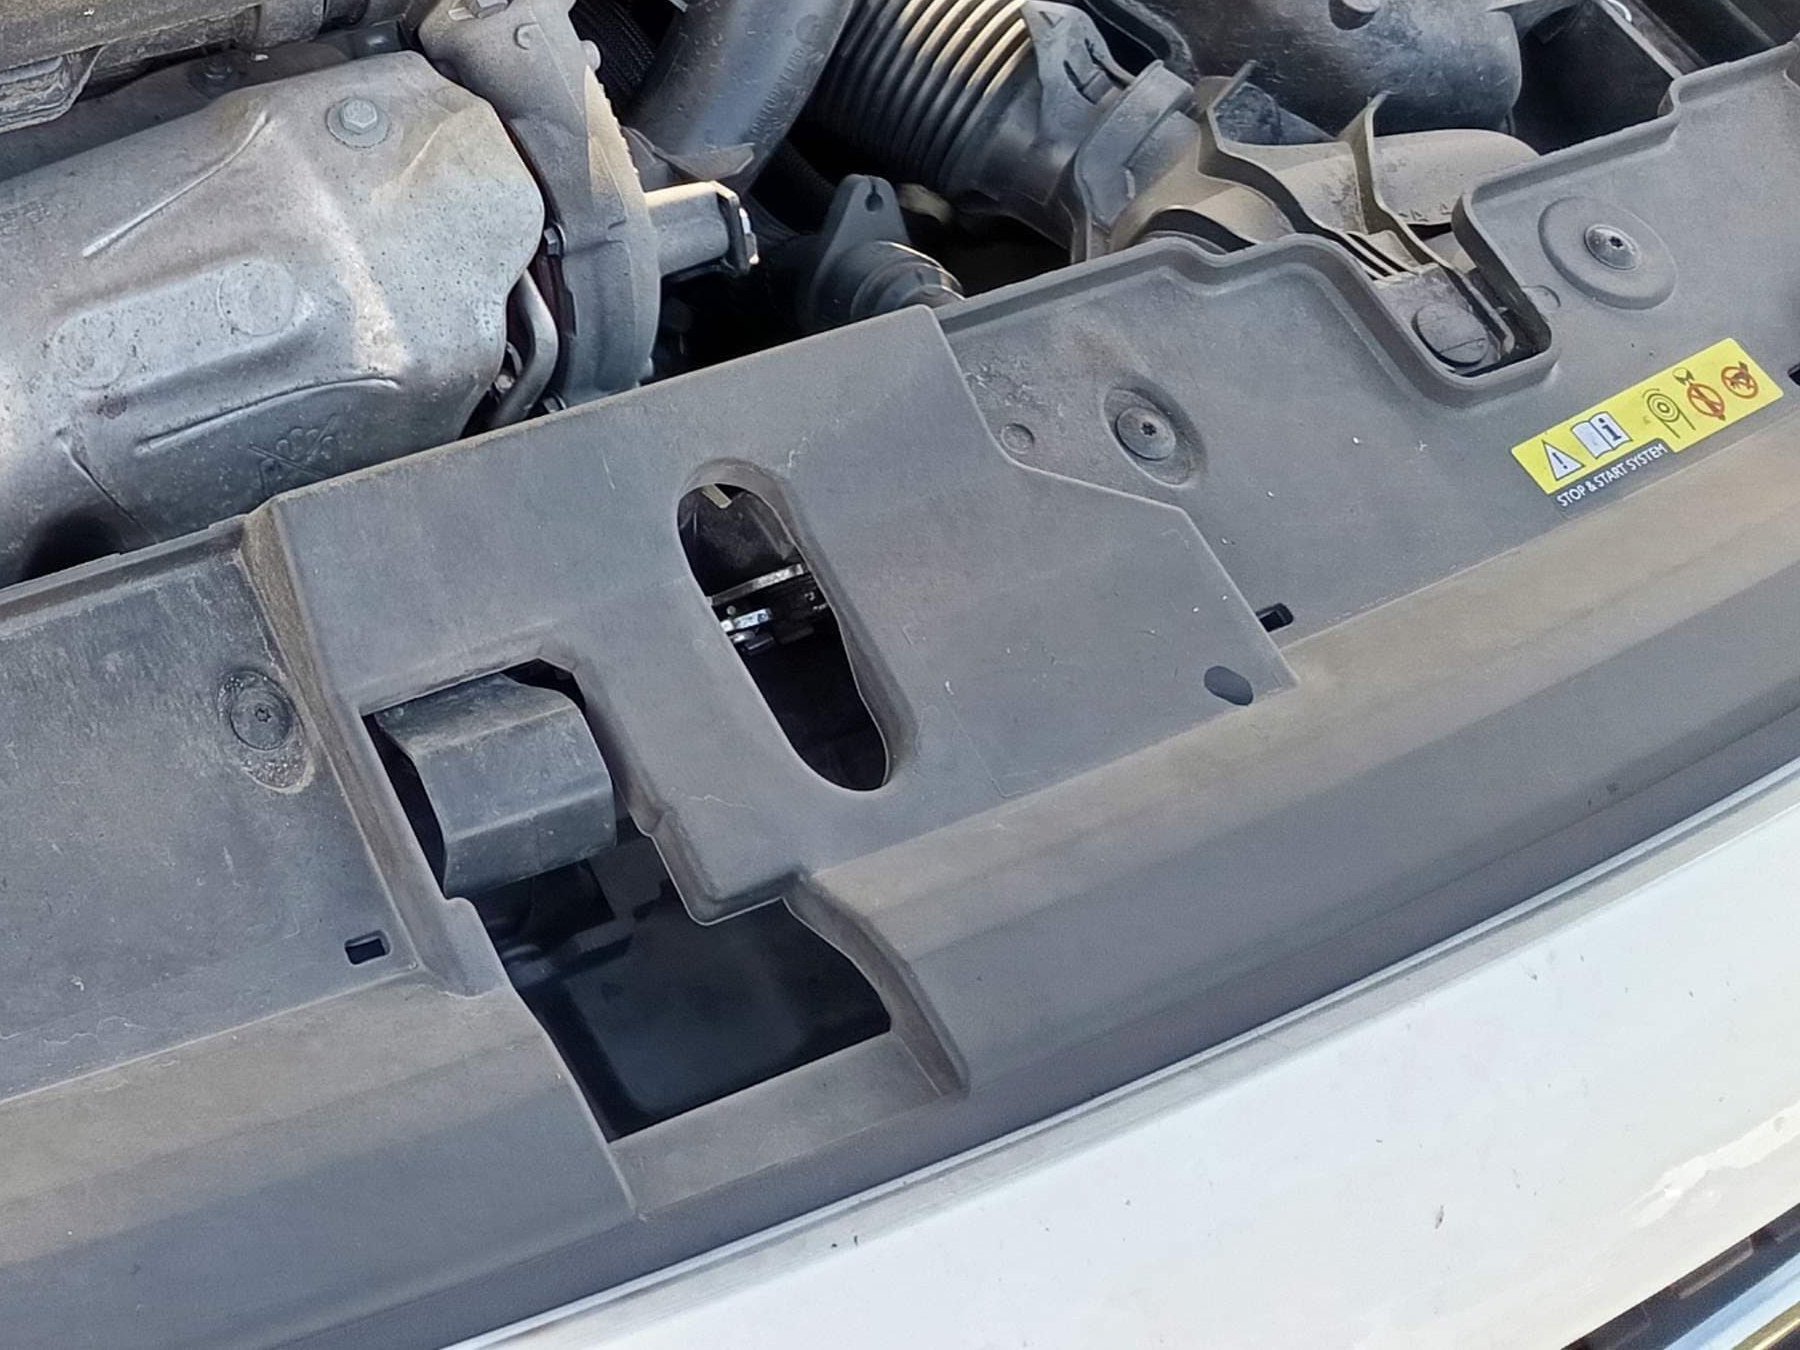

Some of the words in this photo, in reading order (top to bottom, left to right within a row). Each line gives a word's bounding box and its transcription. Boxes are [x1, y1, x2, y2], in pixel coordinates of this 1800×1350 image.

[1556, 482, 1586, 507] STOP
[1586, 478, 1598, 492] &
[1593, 462, 1628, 488] START
[1627, 442, 1668, 471] SYSTEM
